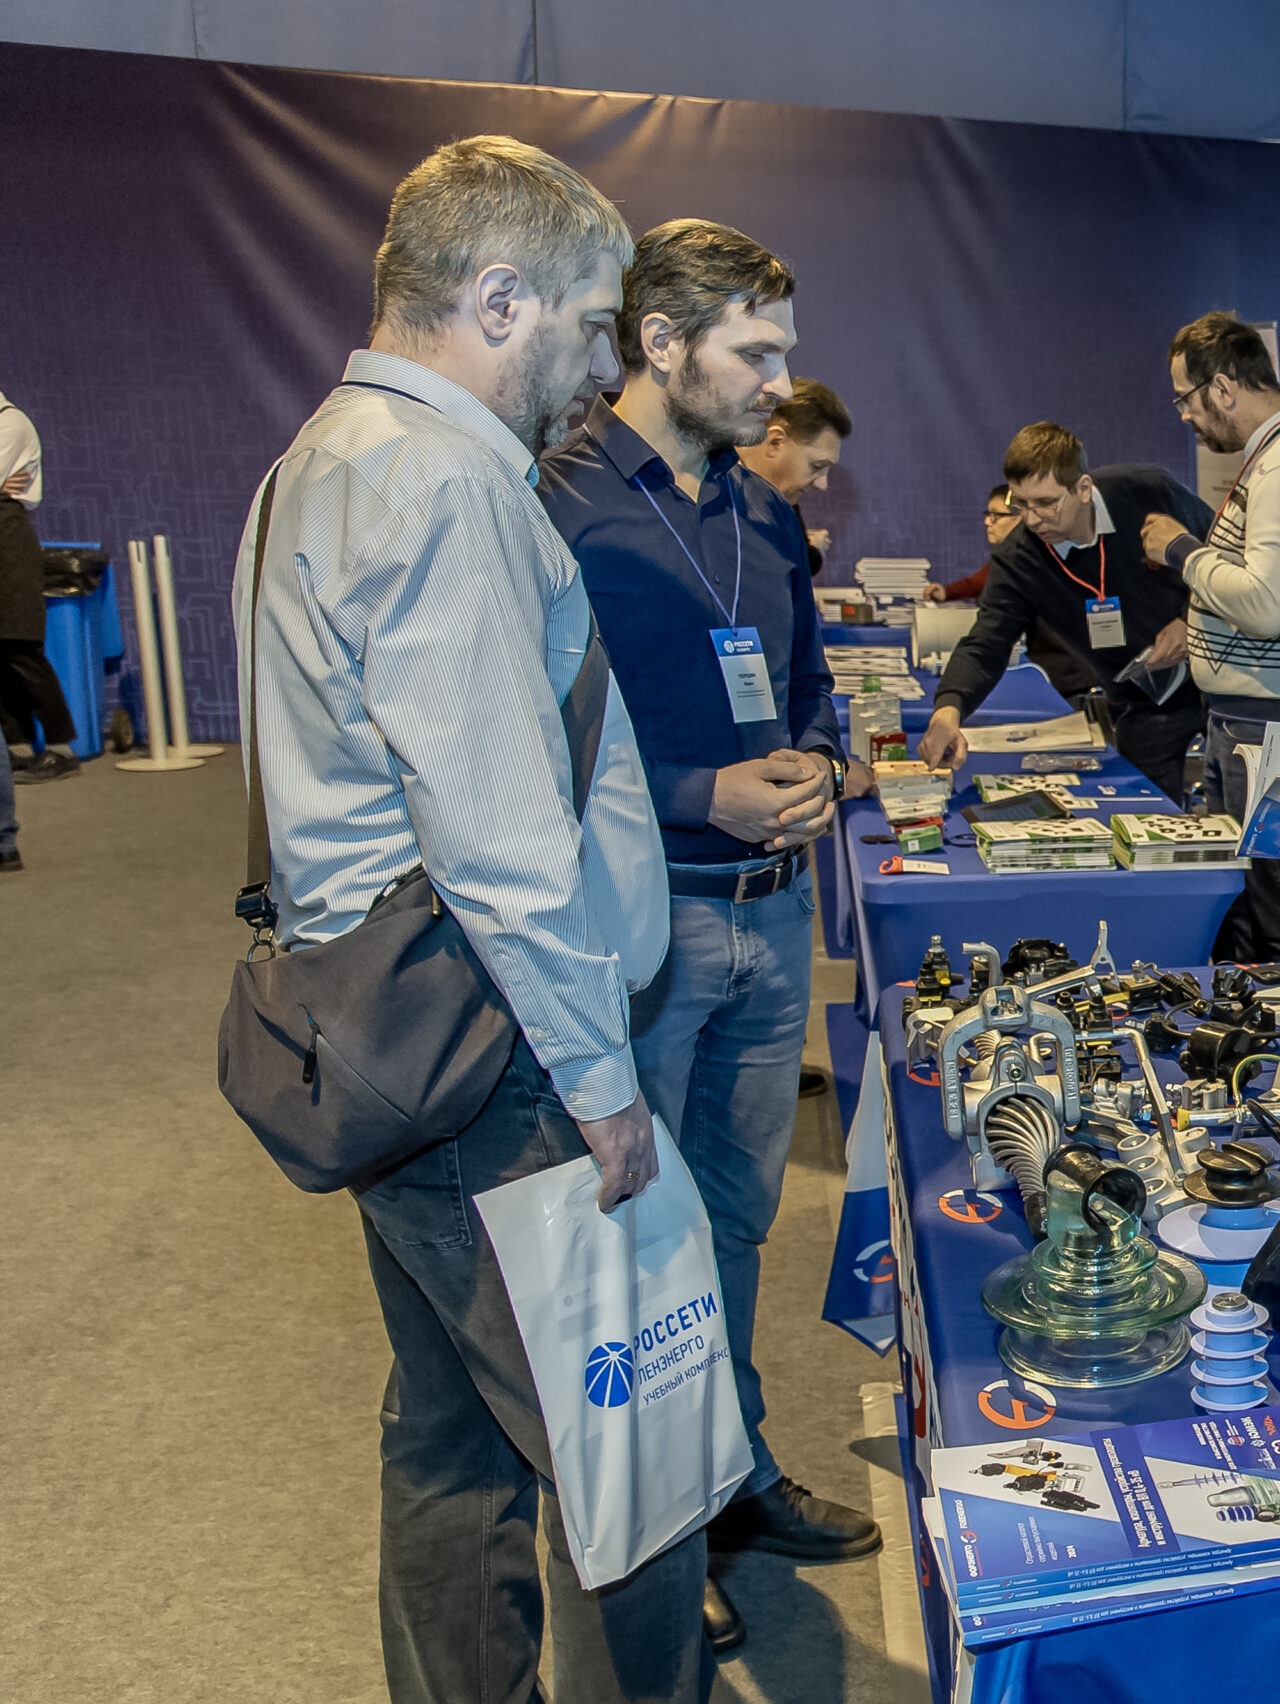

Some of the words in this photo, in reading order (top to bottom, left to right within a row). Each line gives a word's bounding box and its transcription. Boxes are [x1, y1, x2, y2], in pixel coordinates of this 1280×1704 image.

[634, 1291, 718, 1360] РОССЕТИ
[638, 1334, 705, 1385] ЛЕНЭНЕРГО
[643, 1371, 684, 1405] УЧЕБНЫЙ
[684, 1347, 730, 1381] КОМПЛЕКС
[964, 1545, 977, 1577] ФОРЭНЕРГО
